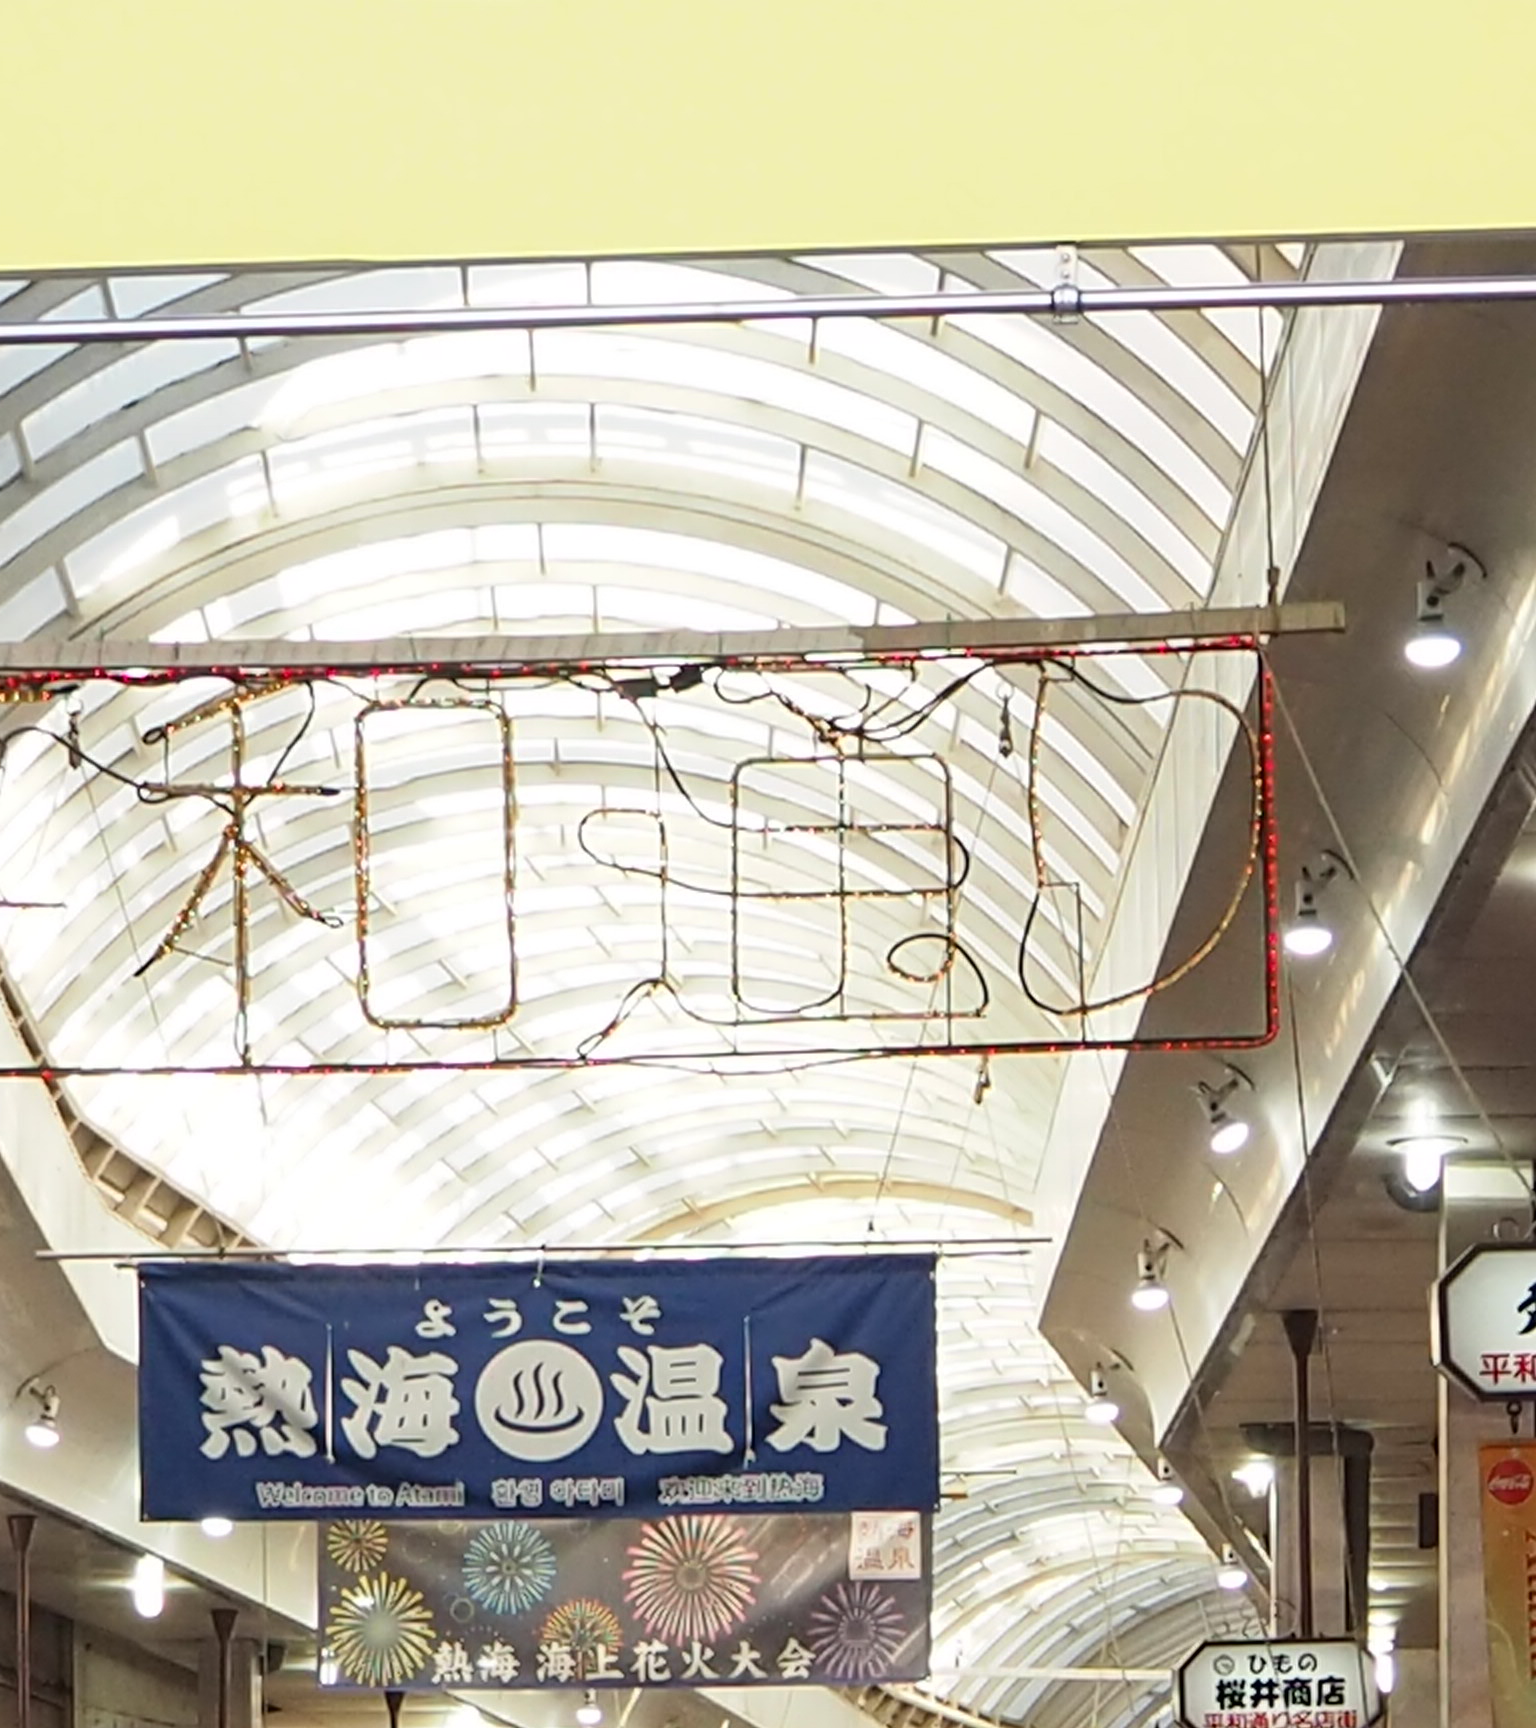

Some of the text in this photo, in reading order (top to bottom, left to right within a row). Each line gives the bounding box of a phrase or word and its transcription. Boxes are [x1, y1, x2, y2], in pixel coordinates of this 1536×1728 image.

[414, 1297, 662, 1338] ようこそ
[199, 1337, 889, 1461] 熱海 温泉
[256, 1481, 465, 1508] Welcome to Atami
[430, 1637, 817, 1684] 熱海 海上花火大会
[1247, 1654, 1318, 1674] ひもの
[1215, 1677, 1347, 1709] 桜井商店
